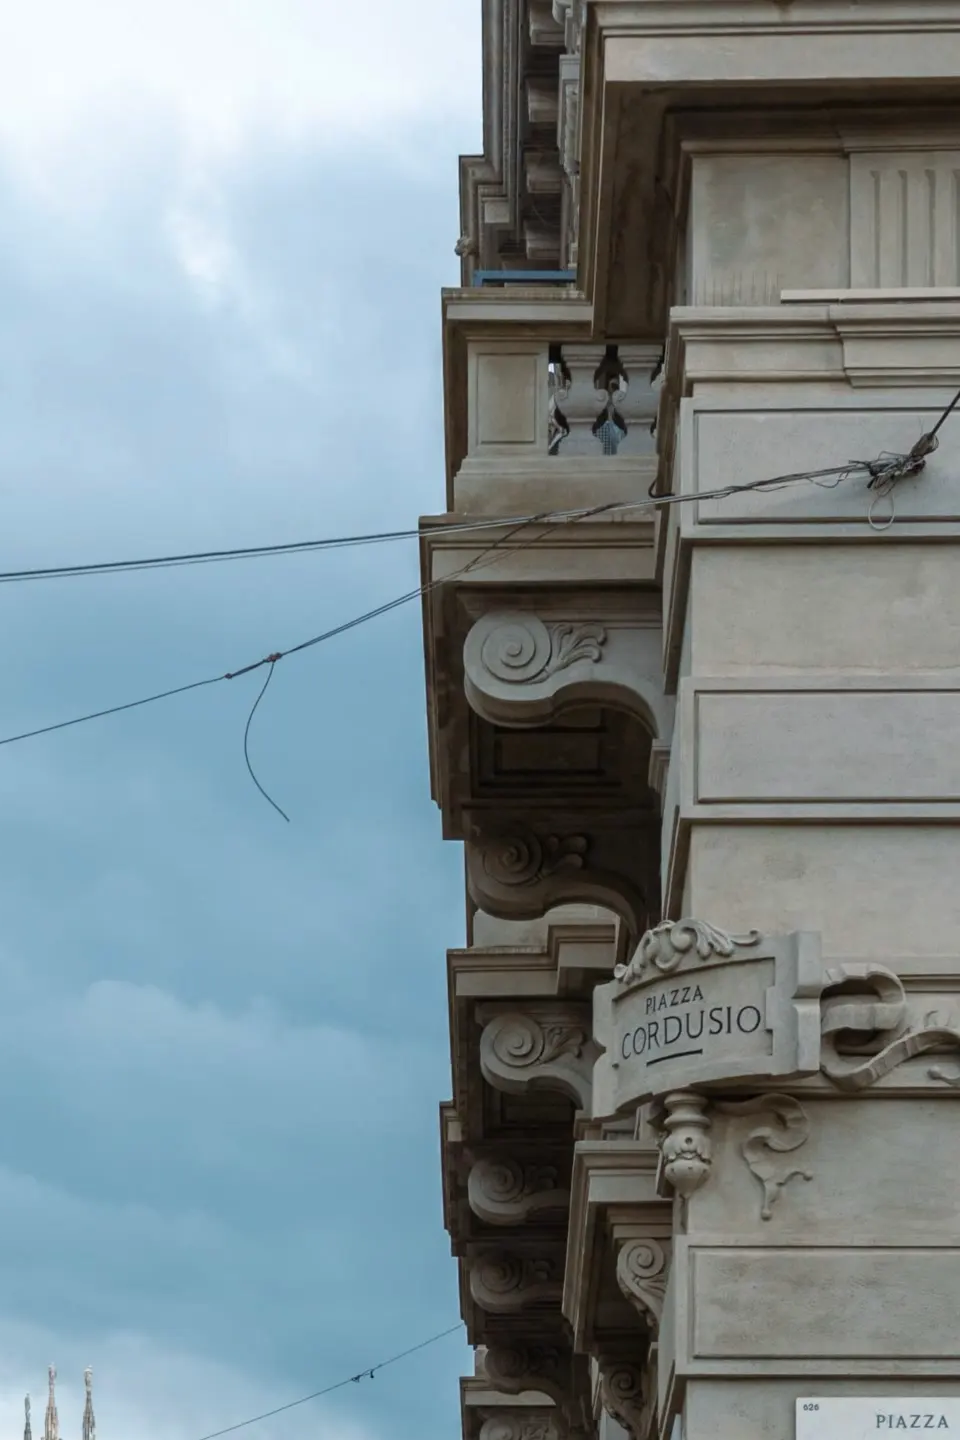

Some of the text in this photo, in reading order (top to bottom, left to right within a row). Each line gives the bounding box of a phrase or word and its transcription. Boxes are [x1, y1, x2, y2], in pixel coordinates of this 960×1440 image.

[646, 985, 704, 1015] PIAZZA
[621, 1005, 761, 1060] CORDUSIO
[803, 1403, 820, 1412] 626
[875, 1414, 949, 1429] PIAZZA
